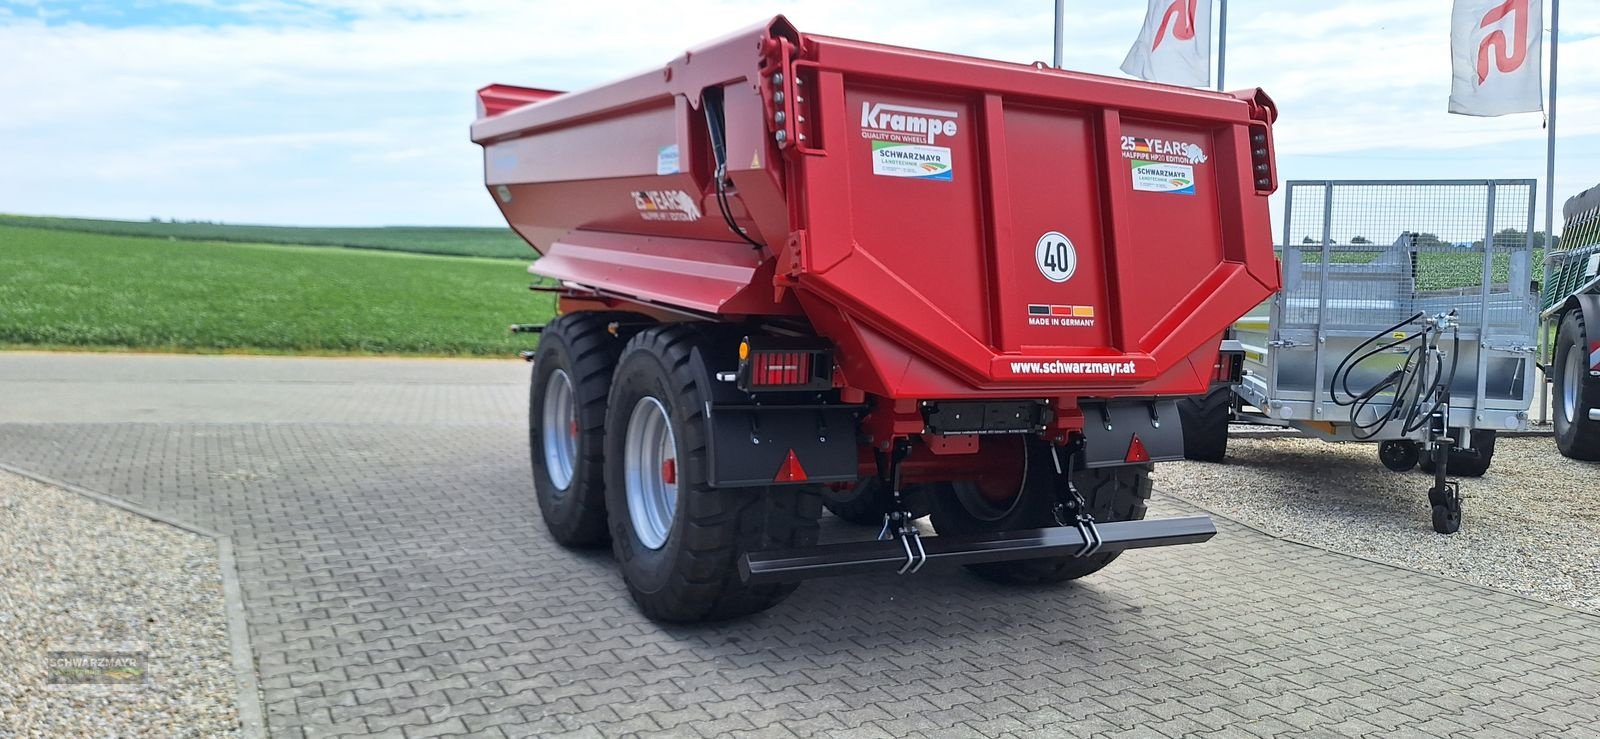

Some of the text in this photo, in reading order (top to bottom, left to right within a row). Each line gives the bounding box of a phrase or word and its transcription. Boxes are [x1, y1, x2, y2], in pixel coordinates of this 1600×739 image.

[861, 101, 958, 145] Krampe
[861, 131, 927, 144] QUALITY ON WHEELS
[1120, 136, 1188, 156] 25 YEARS
[880, 150, 941, 162] SCHWARZMAYR
[1122, 151, 1190, 164] HALFPIPE HP20 EDITION
[1137, 168, 1186, 178] SCHWARZMAYR
[1044, 241, 1069, 273] 40
[1028, 317, 1095, 327] MADE IN GERMANY
[1010, 359, 1136, 376] www.schwarzmayr.at
